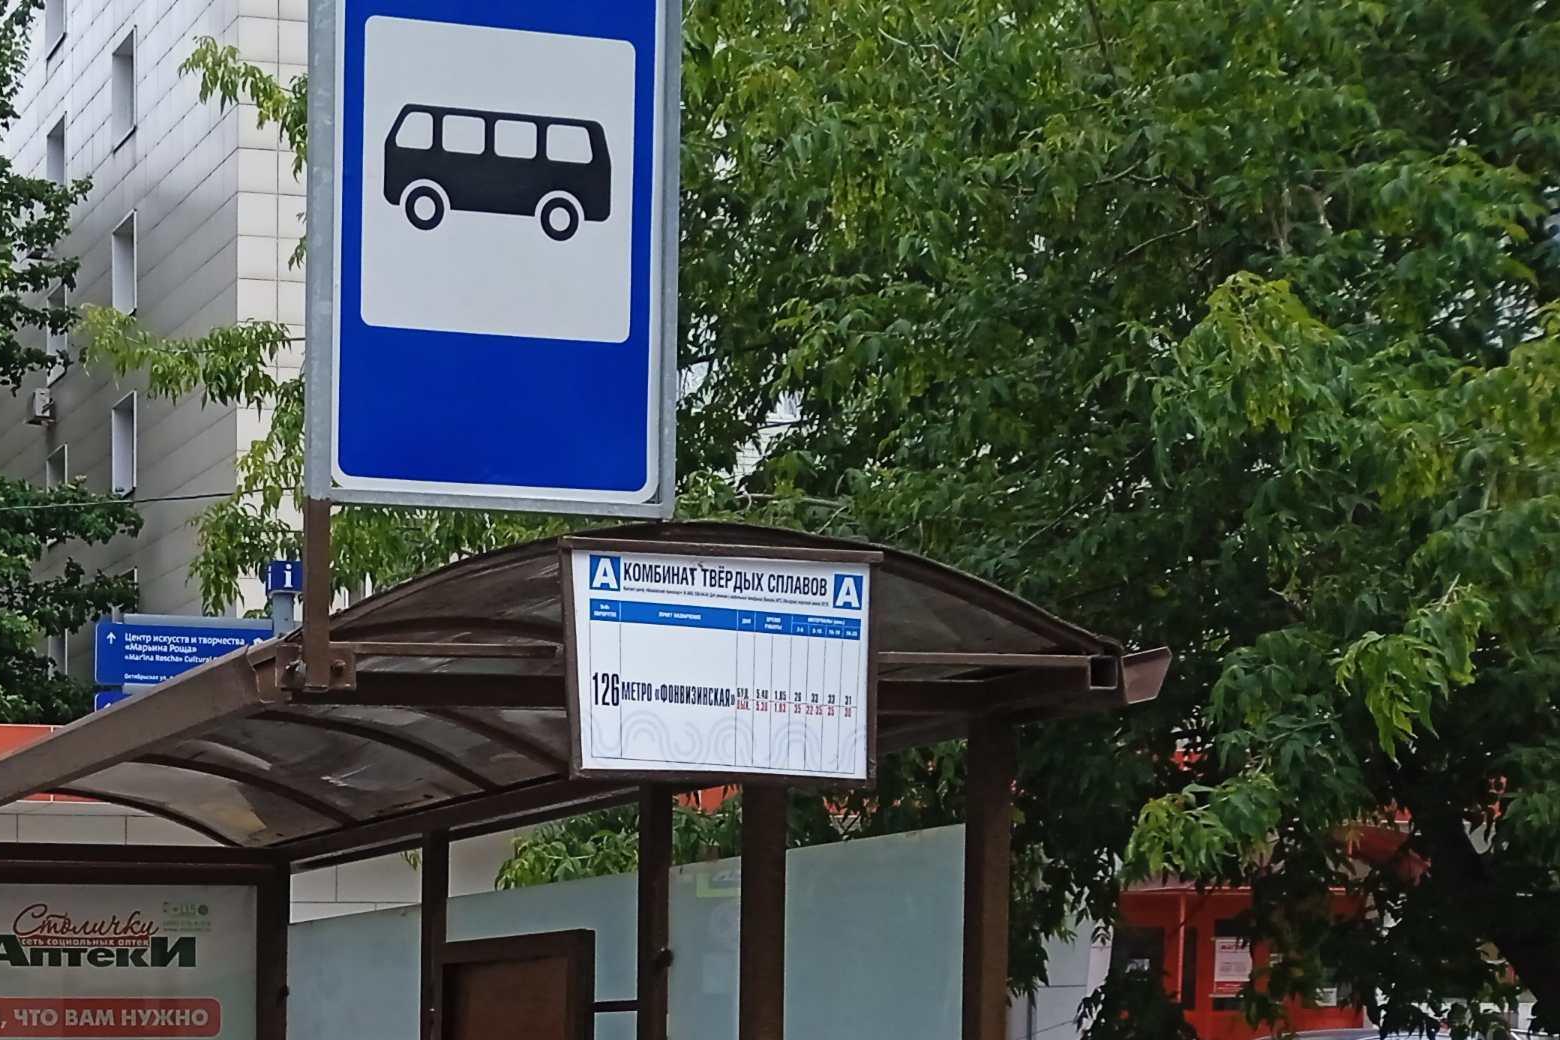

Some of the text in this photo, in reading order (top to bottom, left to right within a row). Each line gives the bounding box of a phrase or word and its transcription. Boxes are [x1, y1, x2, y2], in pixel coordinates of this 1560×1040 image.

[623, 562, 828, 597] КОМБИНАТ ТВЁРДЫХ СПЛАВОВ
[124, 633, 152, 643] Центр
[153, 635, 189, 645] искусств
[198, 637, 245, 646] творчества
[124, 644, 197, 654] «Марьина Роща»
[592, 672, 620, 706] 126
[621, 681, 736, 708] МЕТРО «ФОНВИЗИНСКАЯ»
[12, 903, 160, 936] Столички
[13, 1009, 59, 1026] ЧТО
[65, 1009, 115, 1026] ВАМ
[121, 1009, 209, 1027] НУЖНО
